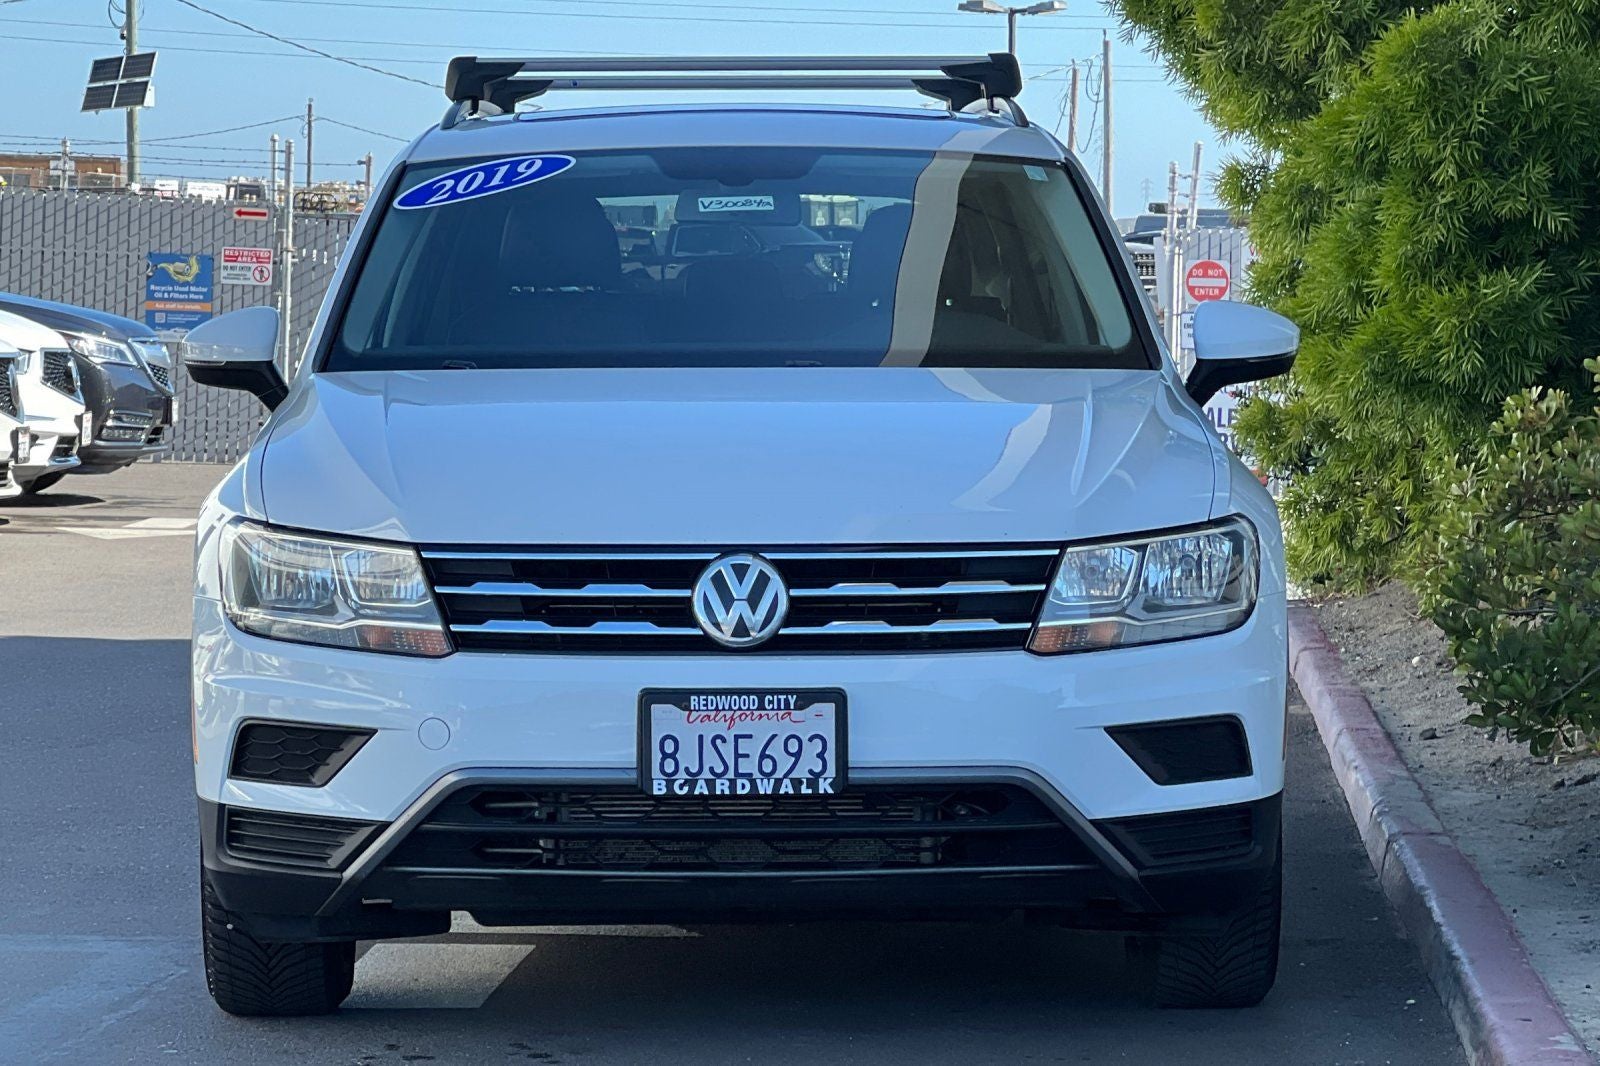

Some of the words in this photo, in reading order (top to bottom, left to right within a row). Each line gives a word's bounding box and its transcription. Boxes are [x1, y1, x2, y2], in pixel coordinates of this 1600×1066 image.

[425, 158, 543, 205] 2019
[150, 284, 173, 292] Recycle
[1194, 287, 1220, 296] ENTER
[690, 695, 759, 711] REDWOOD
[765, 694, 797, 710] CITY
[686, 709, 805, 731] California
[658, 733, 828, 778] 8JSE693
